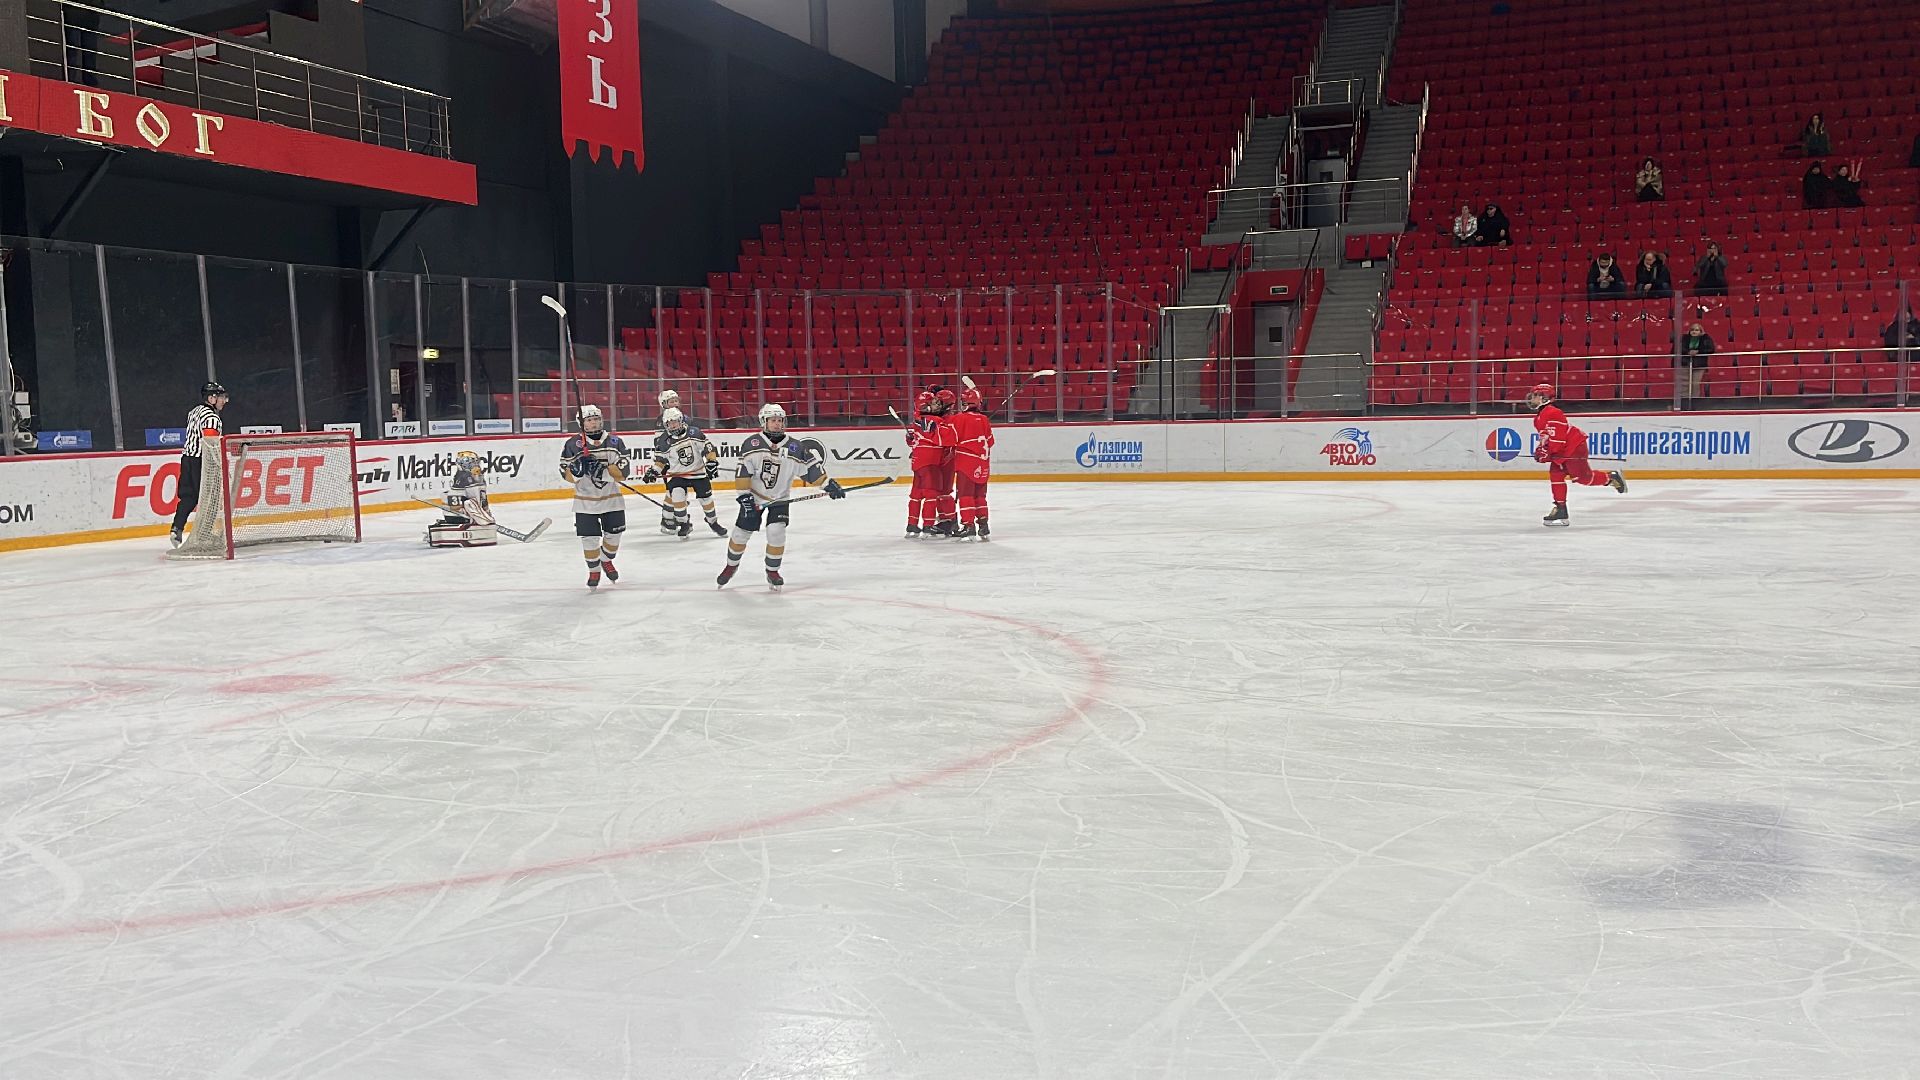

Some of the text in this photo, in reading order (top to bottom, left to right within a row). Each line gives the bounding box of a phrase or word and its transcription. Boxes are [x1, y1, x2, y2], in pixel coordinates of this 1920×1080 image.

[73, 89, 224, 155] БОГ
[1098, 441, 1142, 454] ГАЗПРОМ
[1319, 443, 1357, 455] АВТО
[1529, 426, 1751, 460] снефтегазпром
[397, 451, 524, 481] MarkHckey
[1329, 454, 1376, 466] РАДИО
[112, 456, 324, 519] FOBET
[405, 482, 433, 492] MAKE
